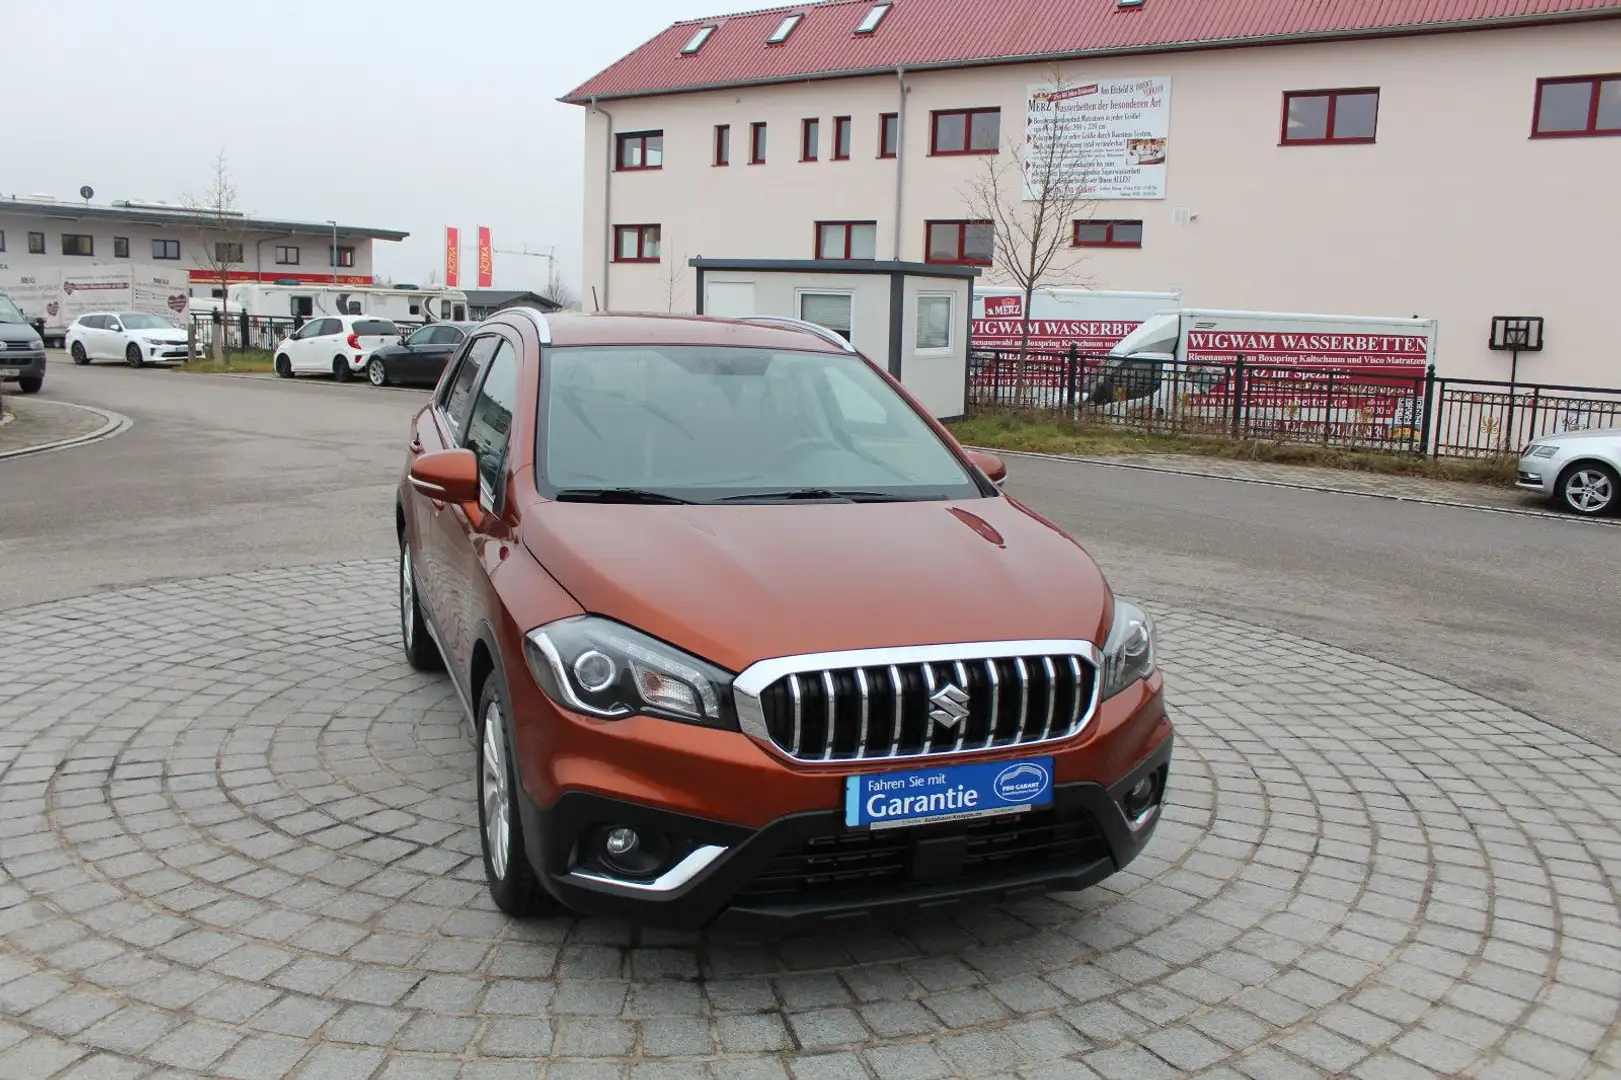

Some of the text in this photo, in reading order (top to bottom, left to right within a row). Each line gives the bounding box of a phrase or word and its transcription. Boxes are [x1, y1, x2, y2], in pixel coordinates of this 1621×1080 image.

[1028, 99, 1052, 112] MERZ
[1110, 98, 1149, 109] besonderen
[1150, 97, 1161, 107] Art
[995, 304, 1021, 316] MERZ
[1062, 340, 1104, 348] Katschaum
[1189, 333, 1428, 352] WIGWAM WASSERBETTEN
[1258, 353, 1298, 364] Boxspring
[1299, 354, 1345, 364] Kaltschaum
[1348, 355, 1362, 364] und
[1364, 356, 1385, 364] Visco
[1386, 356, 1426, 366] Matratzen
[868, 774, 946, 792] Fahren Sie mit
[1015, 782, 1040, 790] GARANT
[867, 785, 978, 818] Garantie
